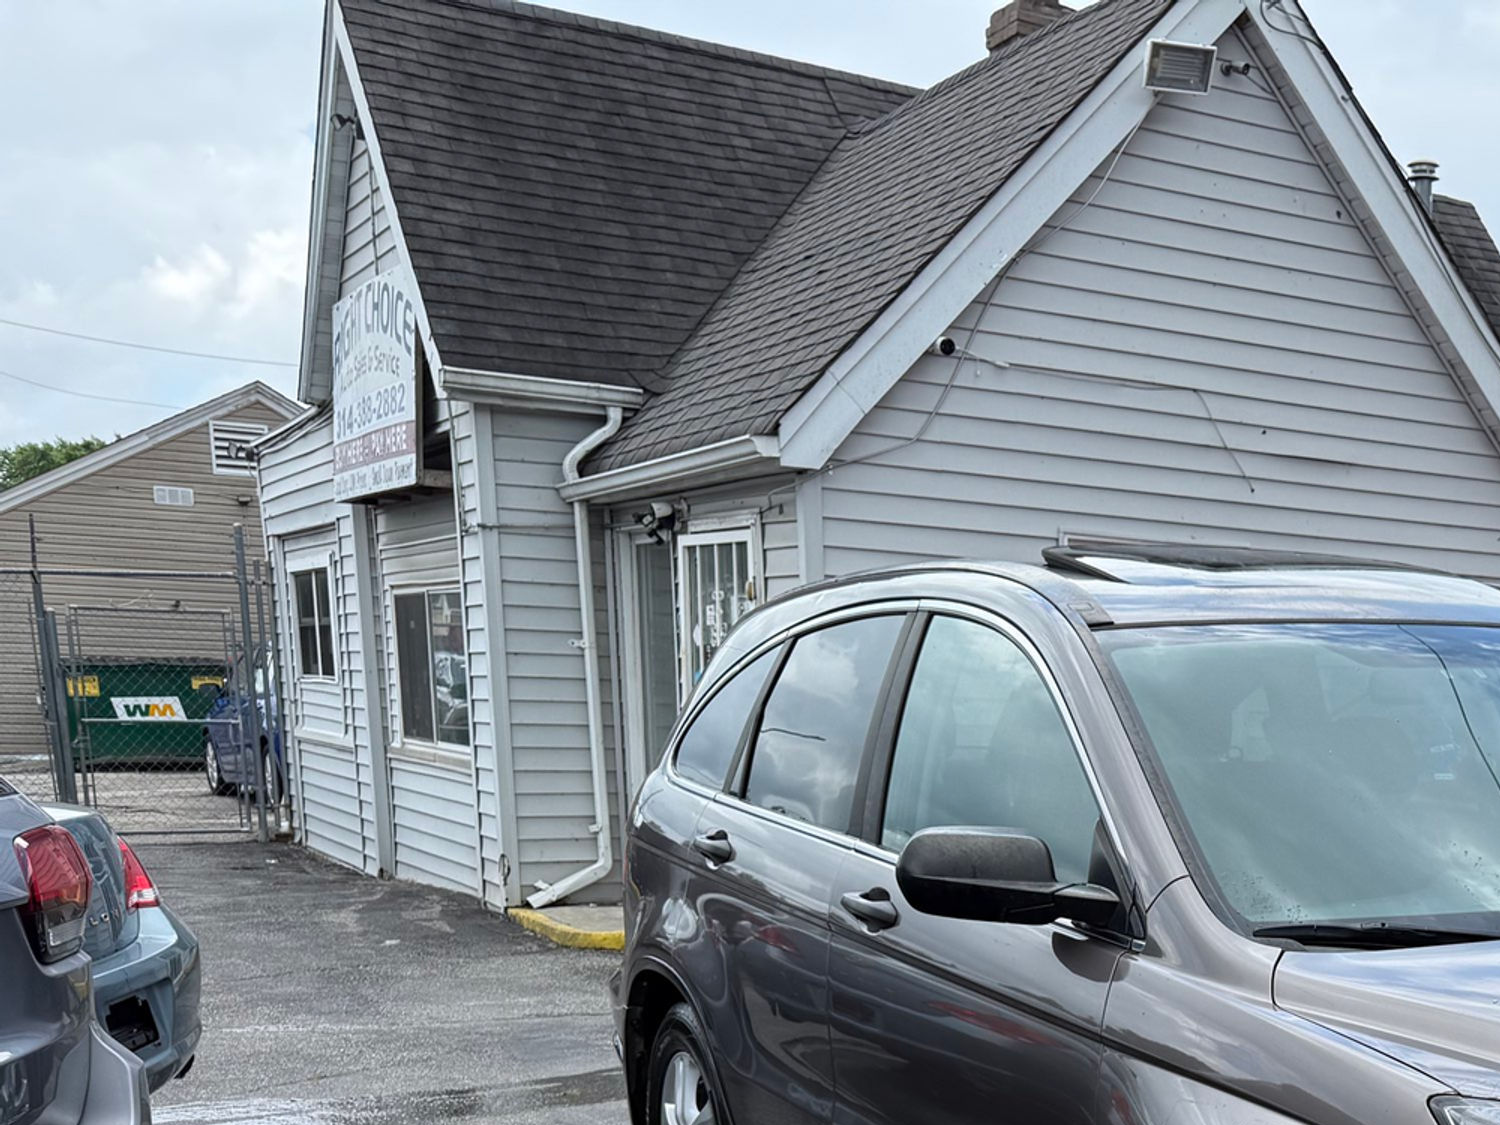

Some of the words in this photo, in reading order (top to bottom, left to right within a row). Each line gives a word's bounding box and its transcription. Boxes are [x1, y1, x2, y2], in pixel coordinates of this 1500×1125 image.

[365, 281, 413, 356] CHOICE
[385, 423, 407, 452] HERE
[123, 703, 177, 718] WM
